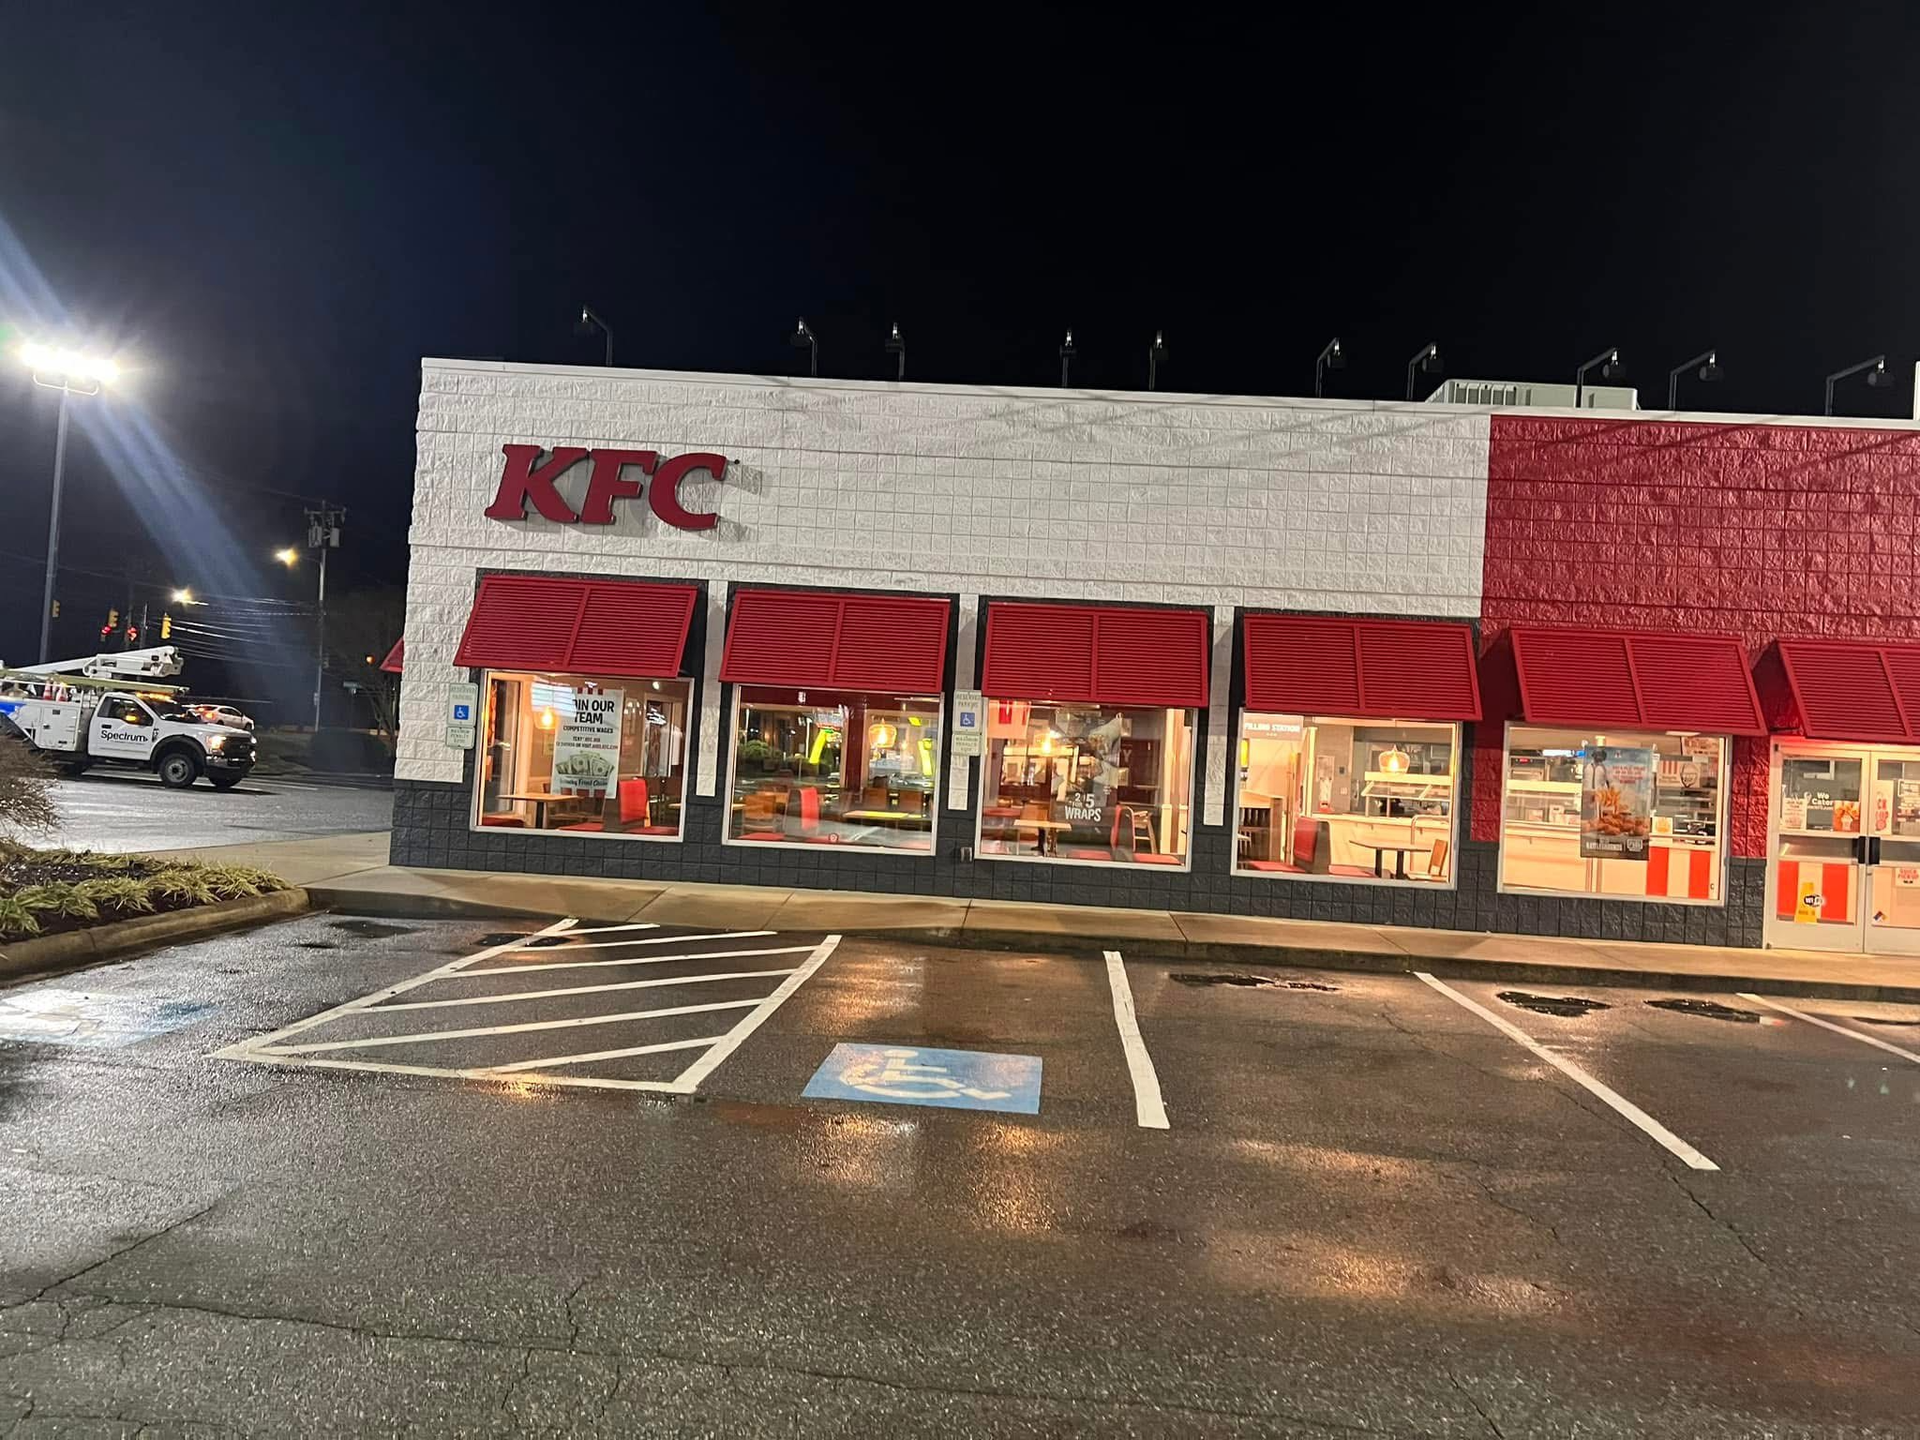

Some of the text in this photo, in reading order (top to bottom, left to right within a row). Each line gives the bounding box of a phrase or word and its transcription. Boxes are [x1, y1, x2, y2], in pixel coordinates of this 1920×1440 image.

[484, 444, 728, 531] KFC
[591, 700, 615, 713] OUR
[574, 711, 603, 724] TEAM
[563, 725, 614, 734] COMPETITIVE WAGES
[101, 730, 147, 742] Spectrum
[1074, 792, 1081, 801] 2
[1812, 798, 1833, 806] Cater
[1816, 792, 1830, 800] We
[1065, 805, 1102, 822] WRAPS
